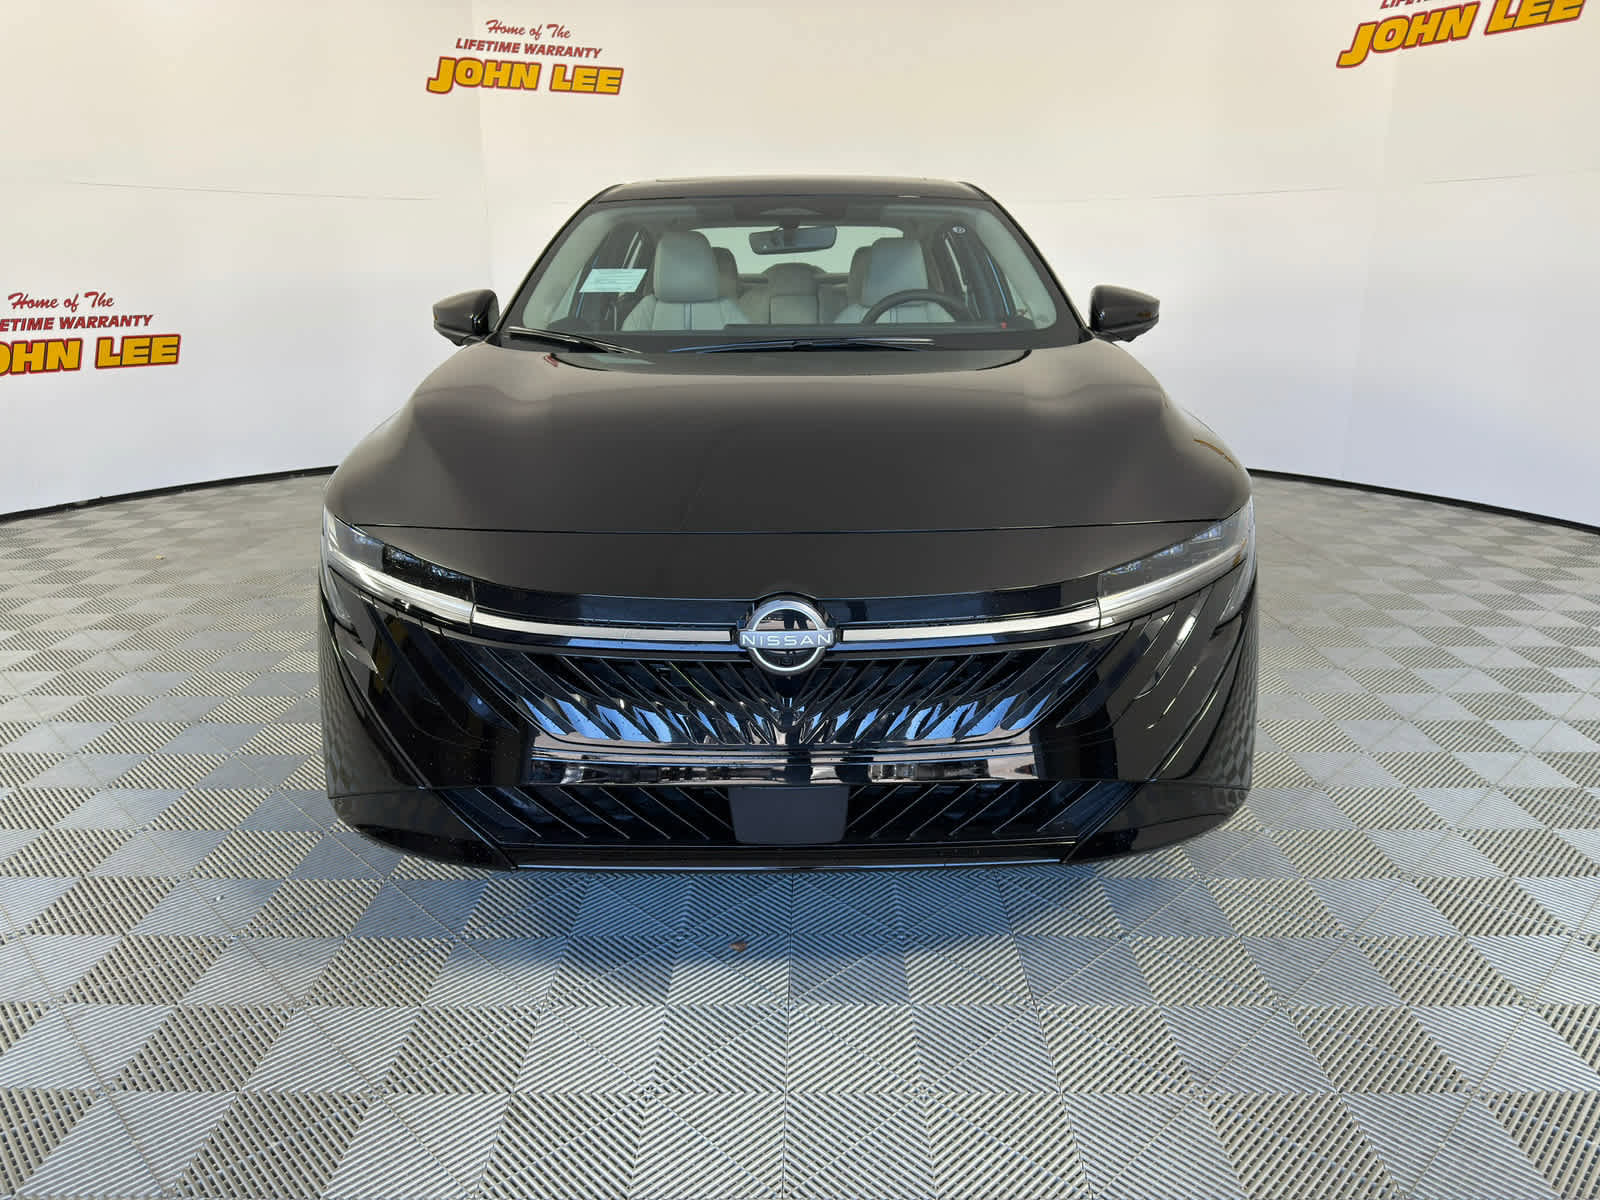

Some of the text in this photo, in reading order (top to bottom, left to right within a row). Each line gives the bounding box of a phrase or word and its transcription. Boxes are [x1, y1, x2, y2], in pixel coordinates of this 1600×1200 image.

[485, 19, 571, 41] Home of The
[1336, 1, 1481, 68] JOHN
[456, 38, 602, 59] LIFETIME WARRANTY
[426, 56, 624, 95] JOHN LEE
[8, 291, 114, 312] Home of The
[59, 314, 153, 329] WARRANTY
[95, 334, 181, 369] LEE
[741, 632, 832, 646] NISSAN
